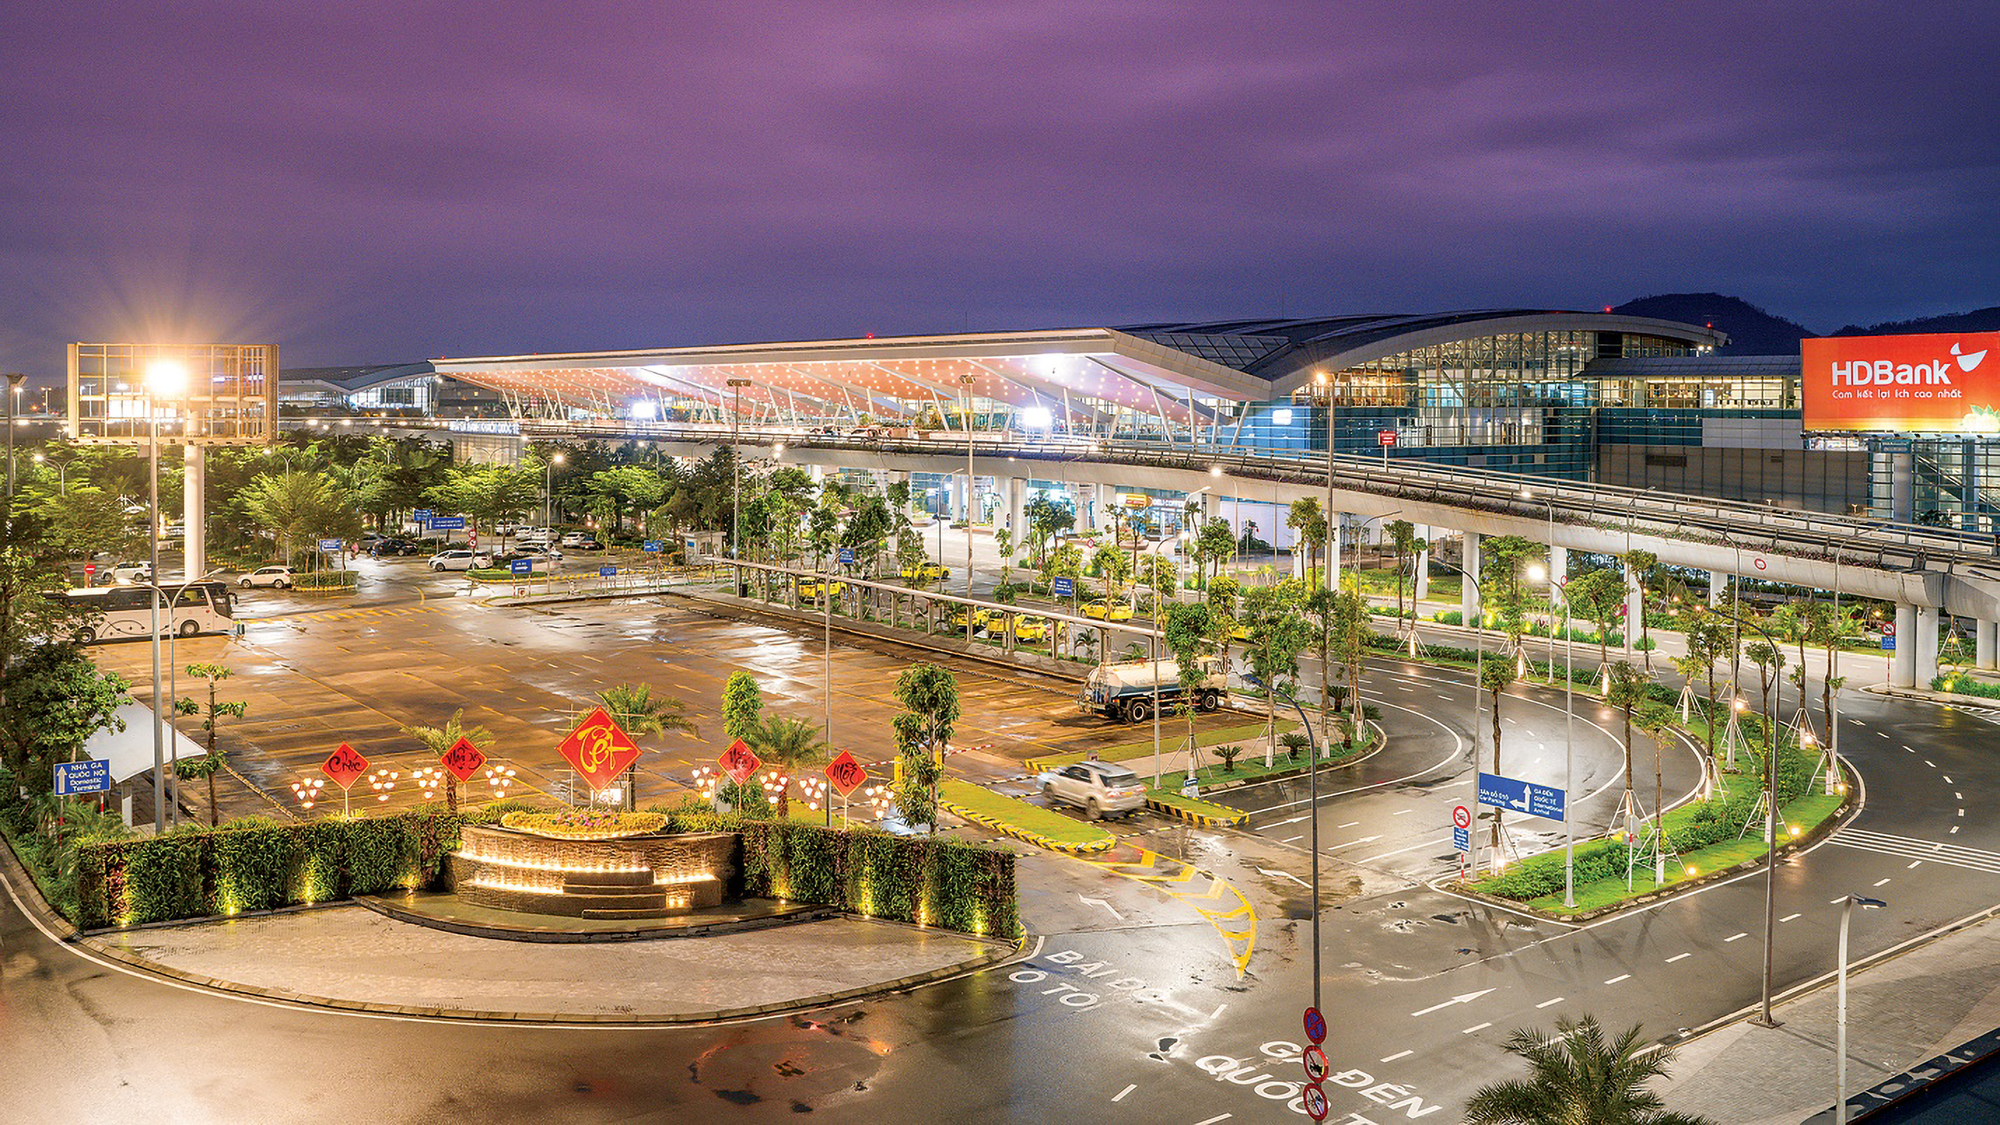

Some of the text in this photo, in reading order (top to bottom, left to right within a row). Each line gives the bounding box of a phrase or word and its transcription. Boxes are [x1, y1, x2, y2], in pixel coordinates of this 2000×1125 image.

[1832, 359, 1951, 386] HDBank
[1832, 390, 1853, 399] Cam
[1937, 388, 1962, 398] nhất
[577, 724, 634, 773] Tết
